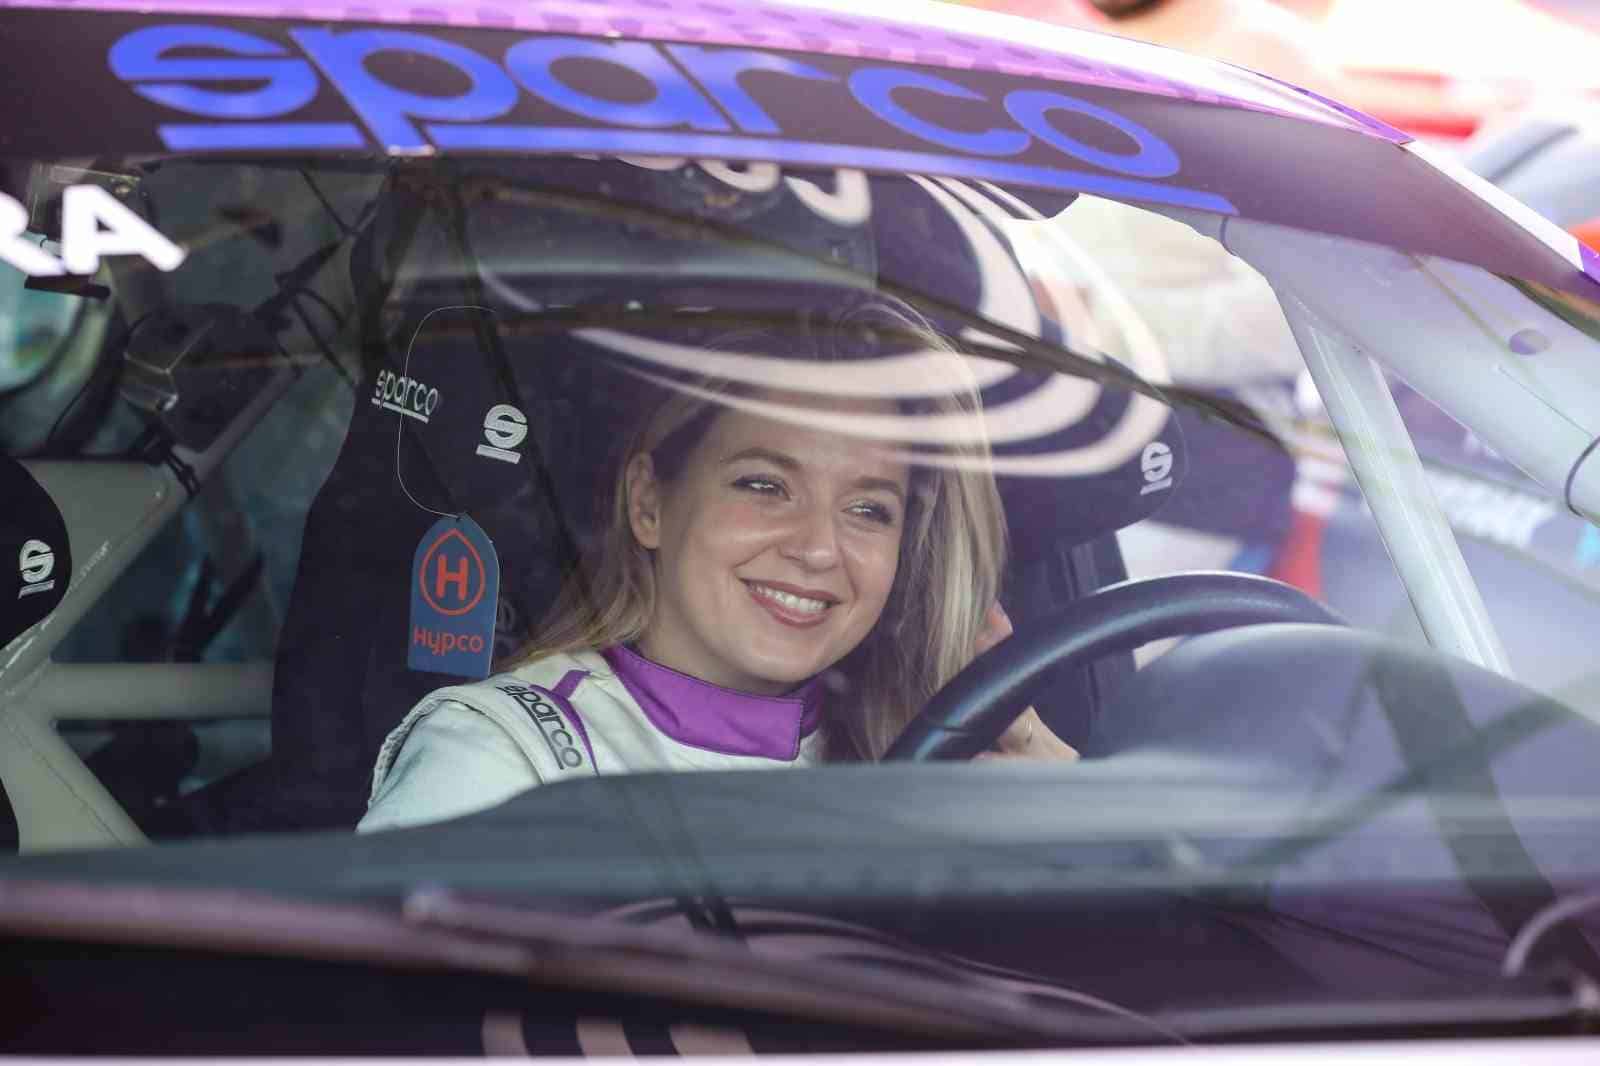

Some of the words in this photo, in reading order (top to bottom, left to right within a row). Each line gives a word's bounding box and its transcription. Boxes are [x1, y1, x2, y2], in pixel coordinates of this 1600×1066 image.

[107, 24, 1181, 178] sparco
[376, 369, 439, 416] sparco
[435, 554, 469, 601] H
[413, 625, 486, 656] Hypco
[503, 685, 582, 768] sparco
